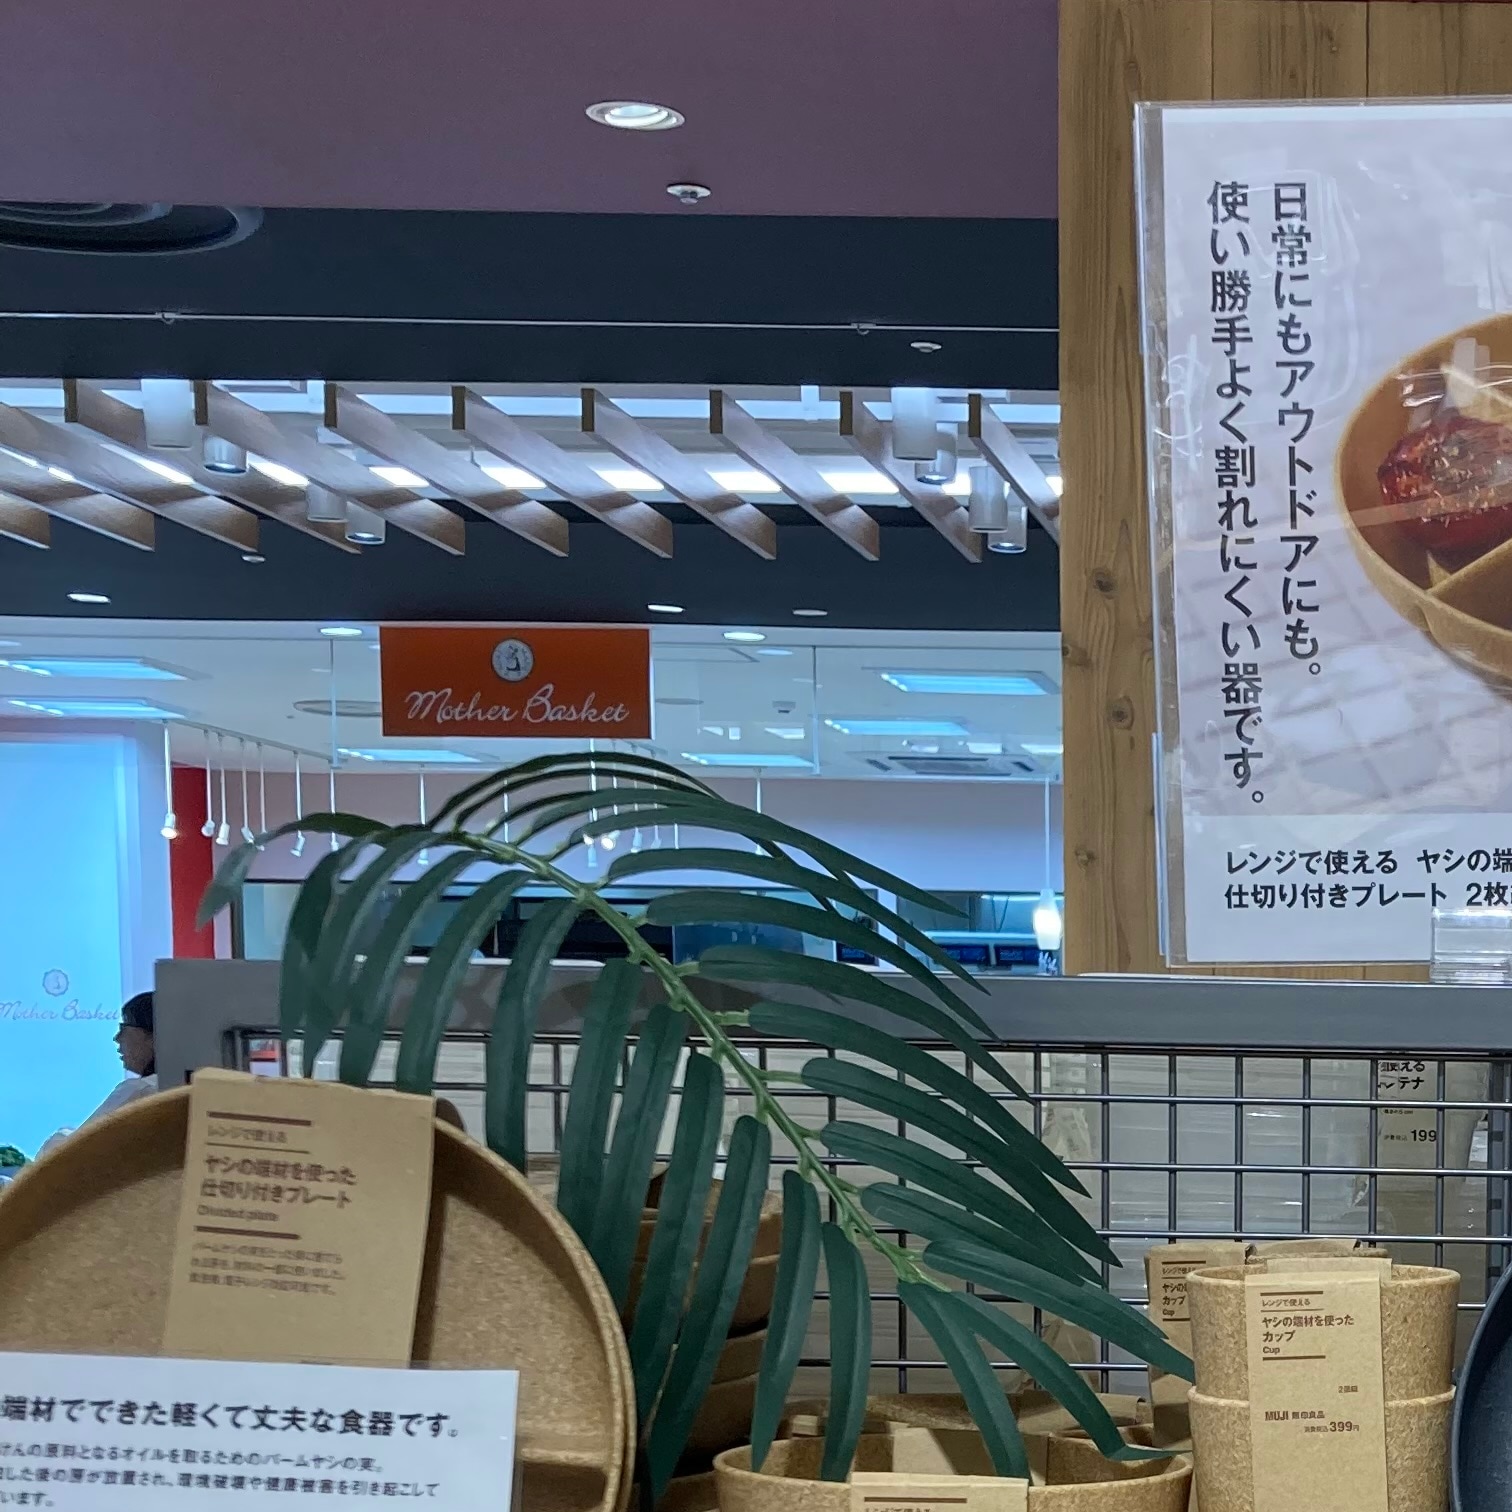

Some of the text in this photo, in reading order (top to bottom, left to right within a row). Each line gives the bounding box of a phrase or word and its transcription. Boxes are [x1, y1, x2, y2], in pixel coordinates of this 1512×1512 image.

[1272, 181, 1322, 677] 日常にもアウトドアにも。
[1208, 181, 1266, 803] 使い勝手よく割れにくい器です。
[405, 683, 629, 724] Mother Basket
[1226, 849, 1398, 875] レンジで使える
[1226, 882, 1448, 909] 仕切り付きプレート
[1261, 1314, 1354, 1328] ヤシの端材を使った
[1263, 1330, 1296, 1342] カップ
[1263, 1346, 1280, 1355] Cup
[0, 1395, 459, 1438] 端材でできた軽くて丈夫な食器です。
[1265, 1411, 1288, 1421] MUJI
